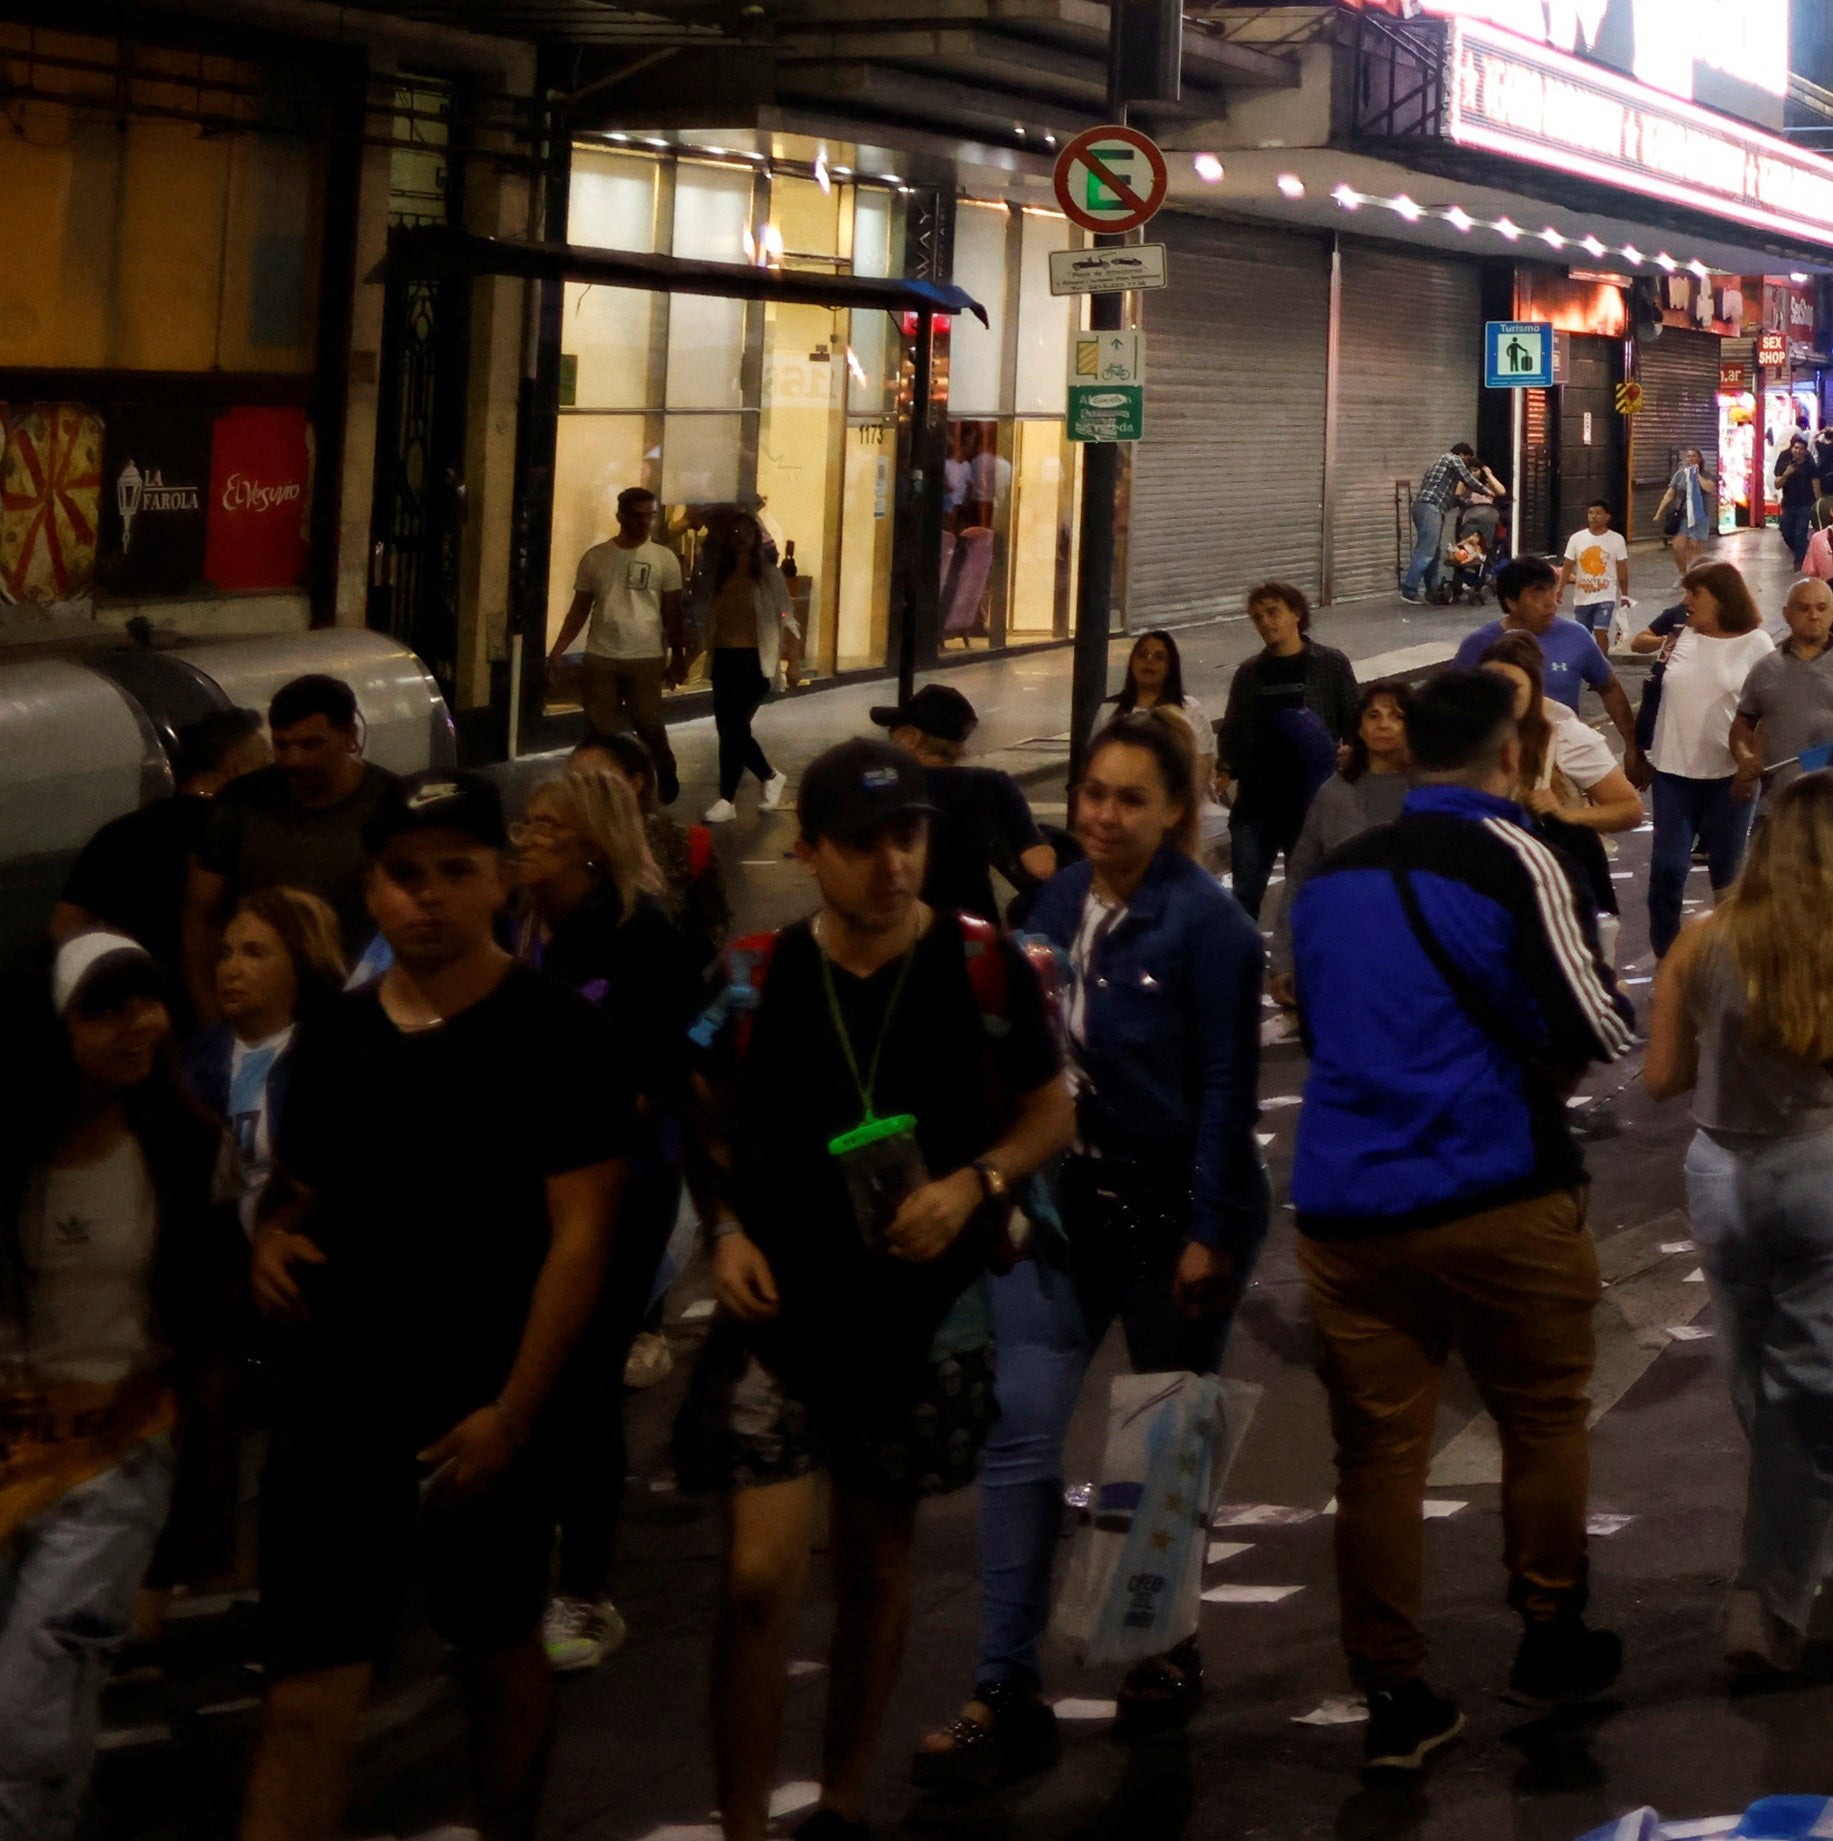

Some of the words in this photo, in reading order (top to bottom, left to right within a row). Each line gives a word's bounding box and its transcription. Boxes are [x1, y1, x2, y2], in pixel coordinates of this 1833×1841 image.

[1500, 324, 1540, 333] Turismo
[1762, 336, 1782, 349] SEX
[1759, 351, 1785, 364] SHOP
[859, 424, 884, 444] 1173
[145, 470, 163, 487] LA
[143, 492, 198, 511] FAROLA
